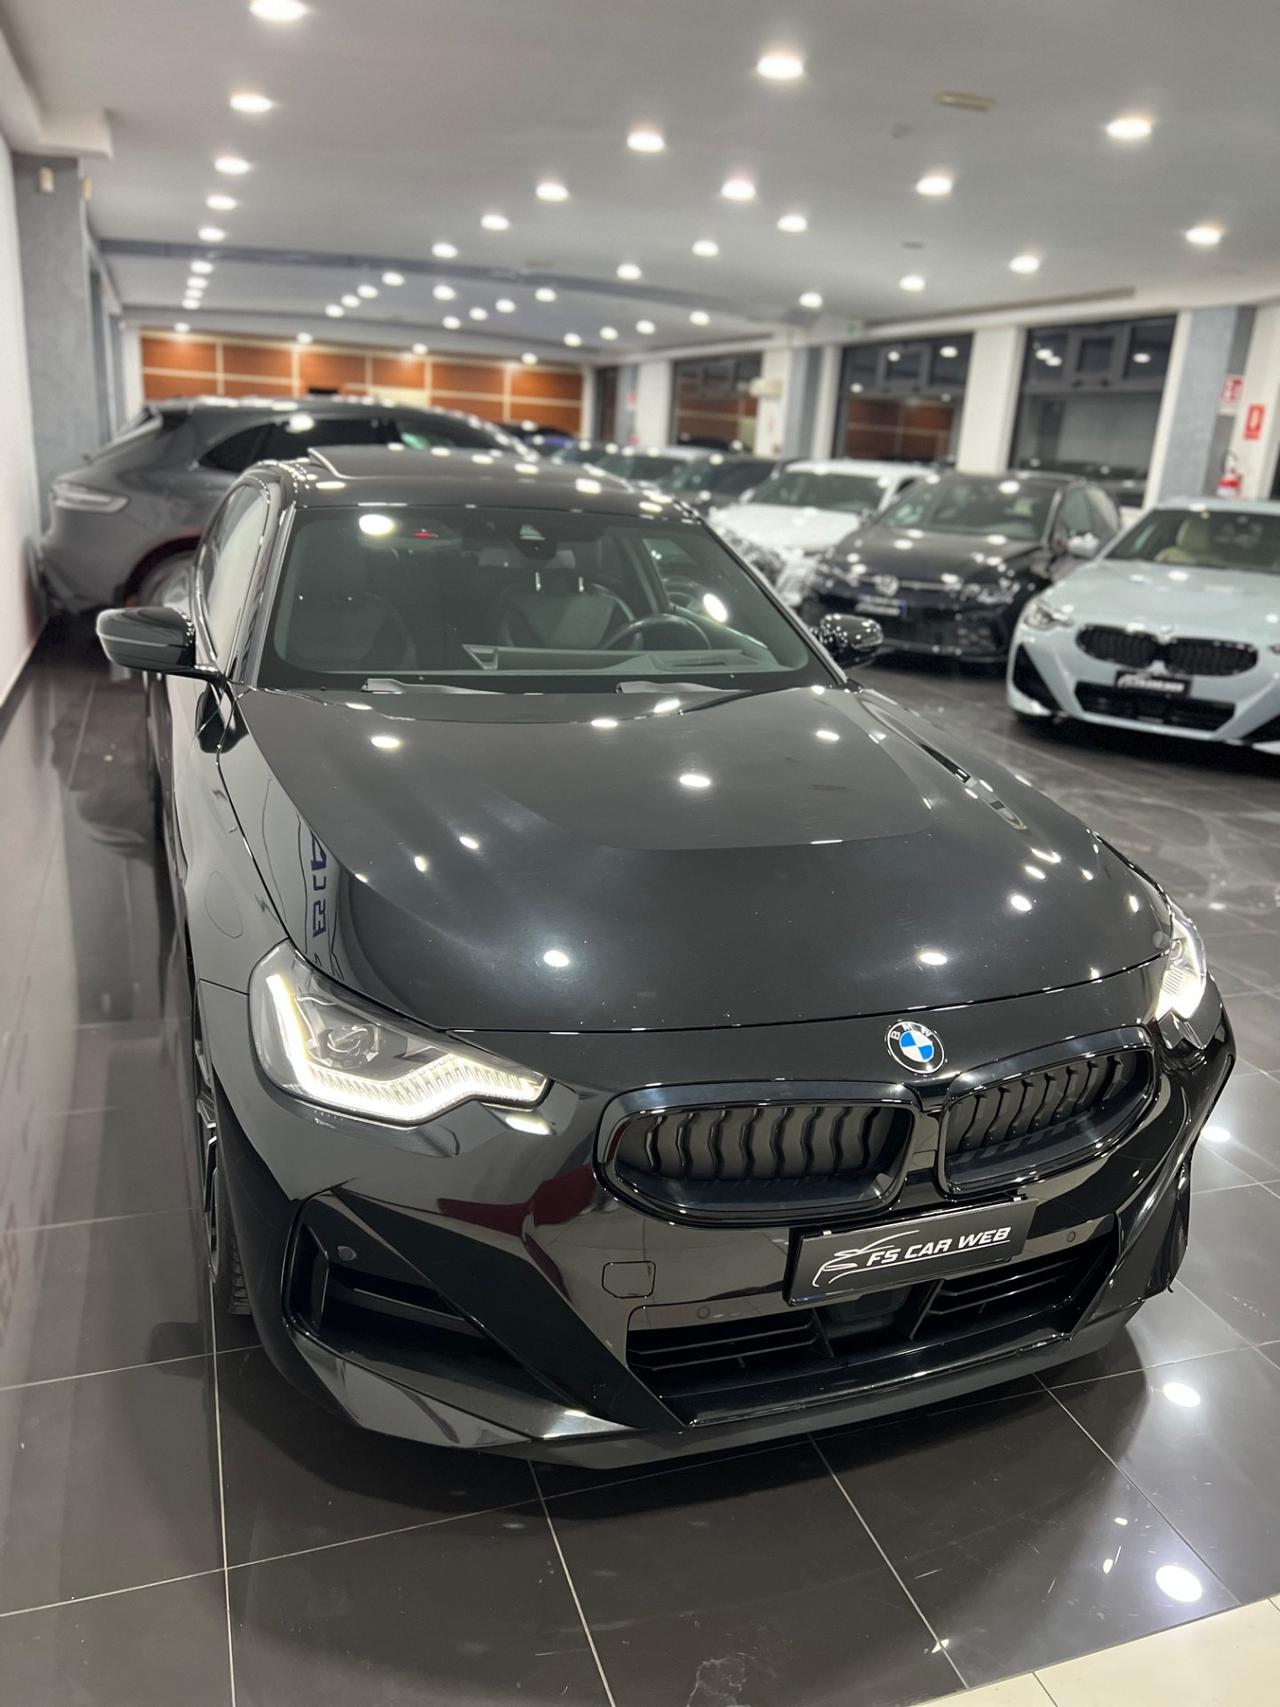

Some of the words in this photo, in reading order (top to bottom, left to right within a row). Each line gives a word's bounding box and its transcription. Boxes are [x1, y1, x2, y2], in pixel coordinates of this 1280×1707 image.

[890, 1022, 932, 1040] BMW
[866, 1247, 902, 1267] FS
[903, 1238, 950, 1260] CAR
[957, 1226, 1012, 1249] WEB
